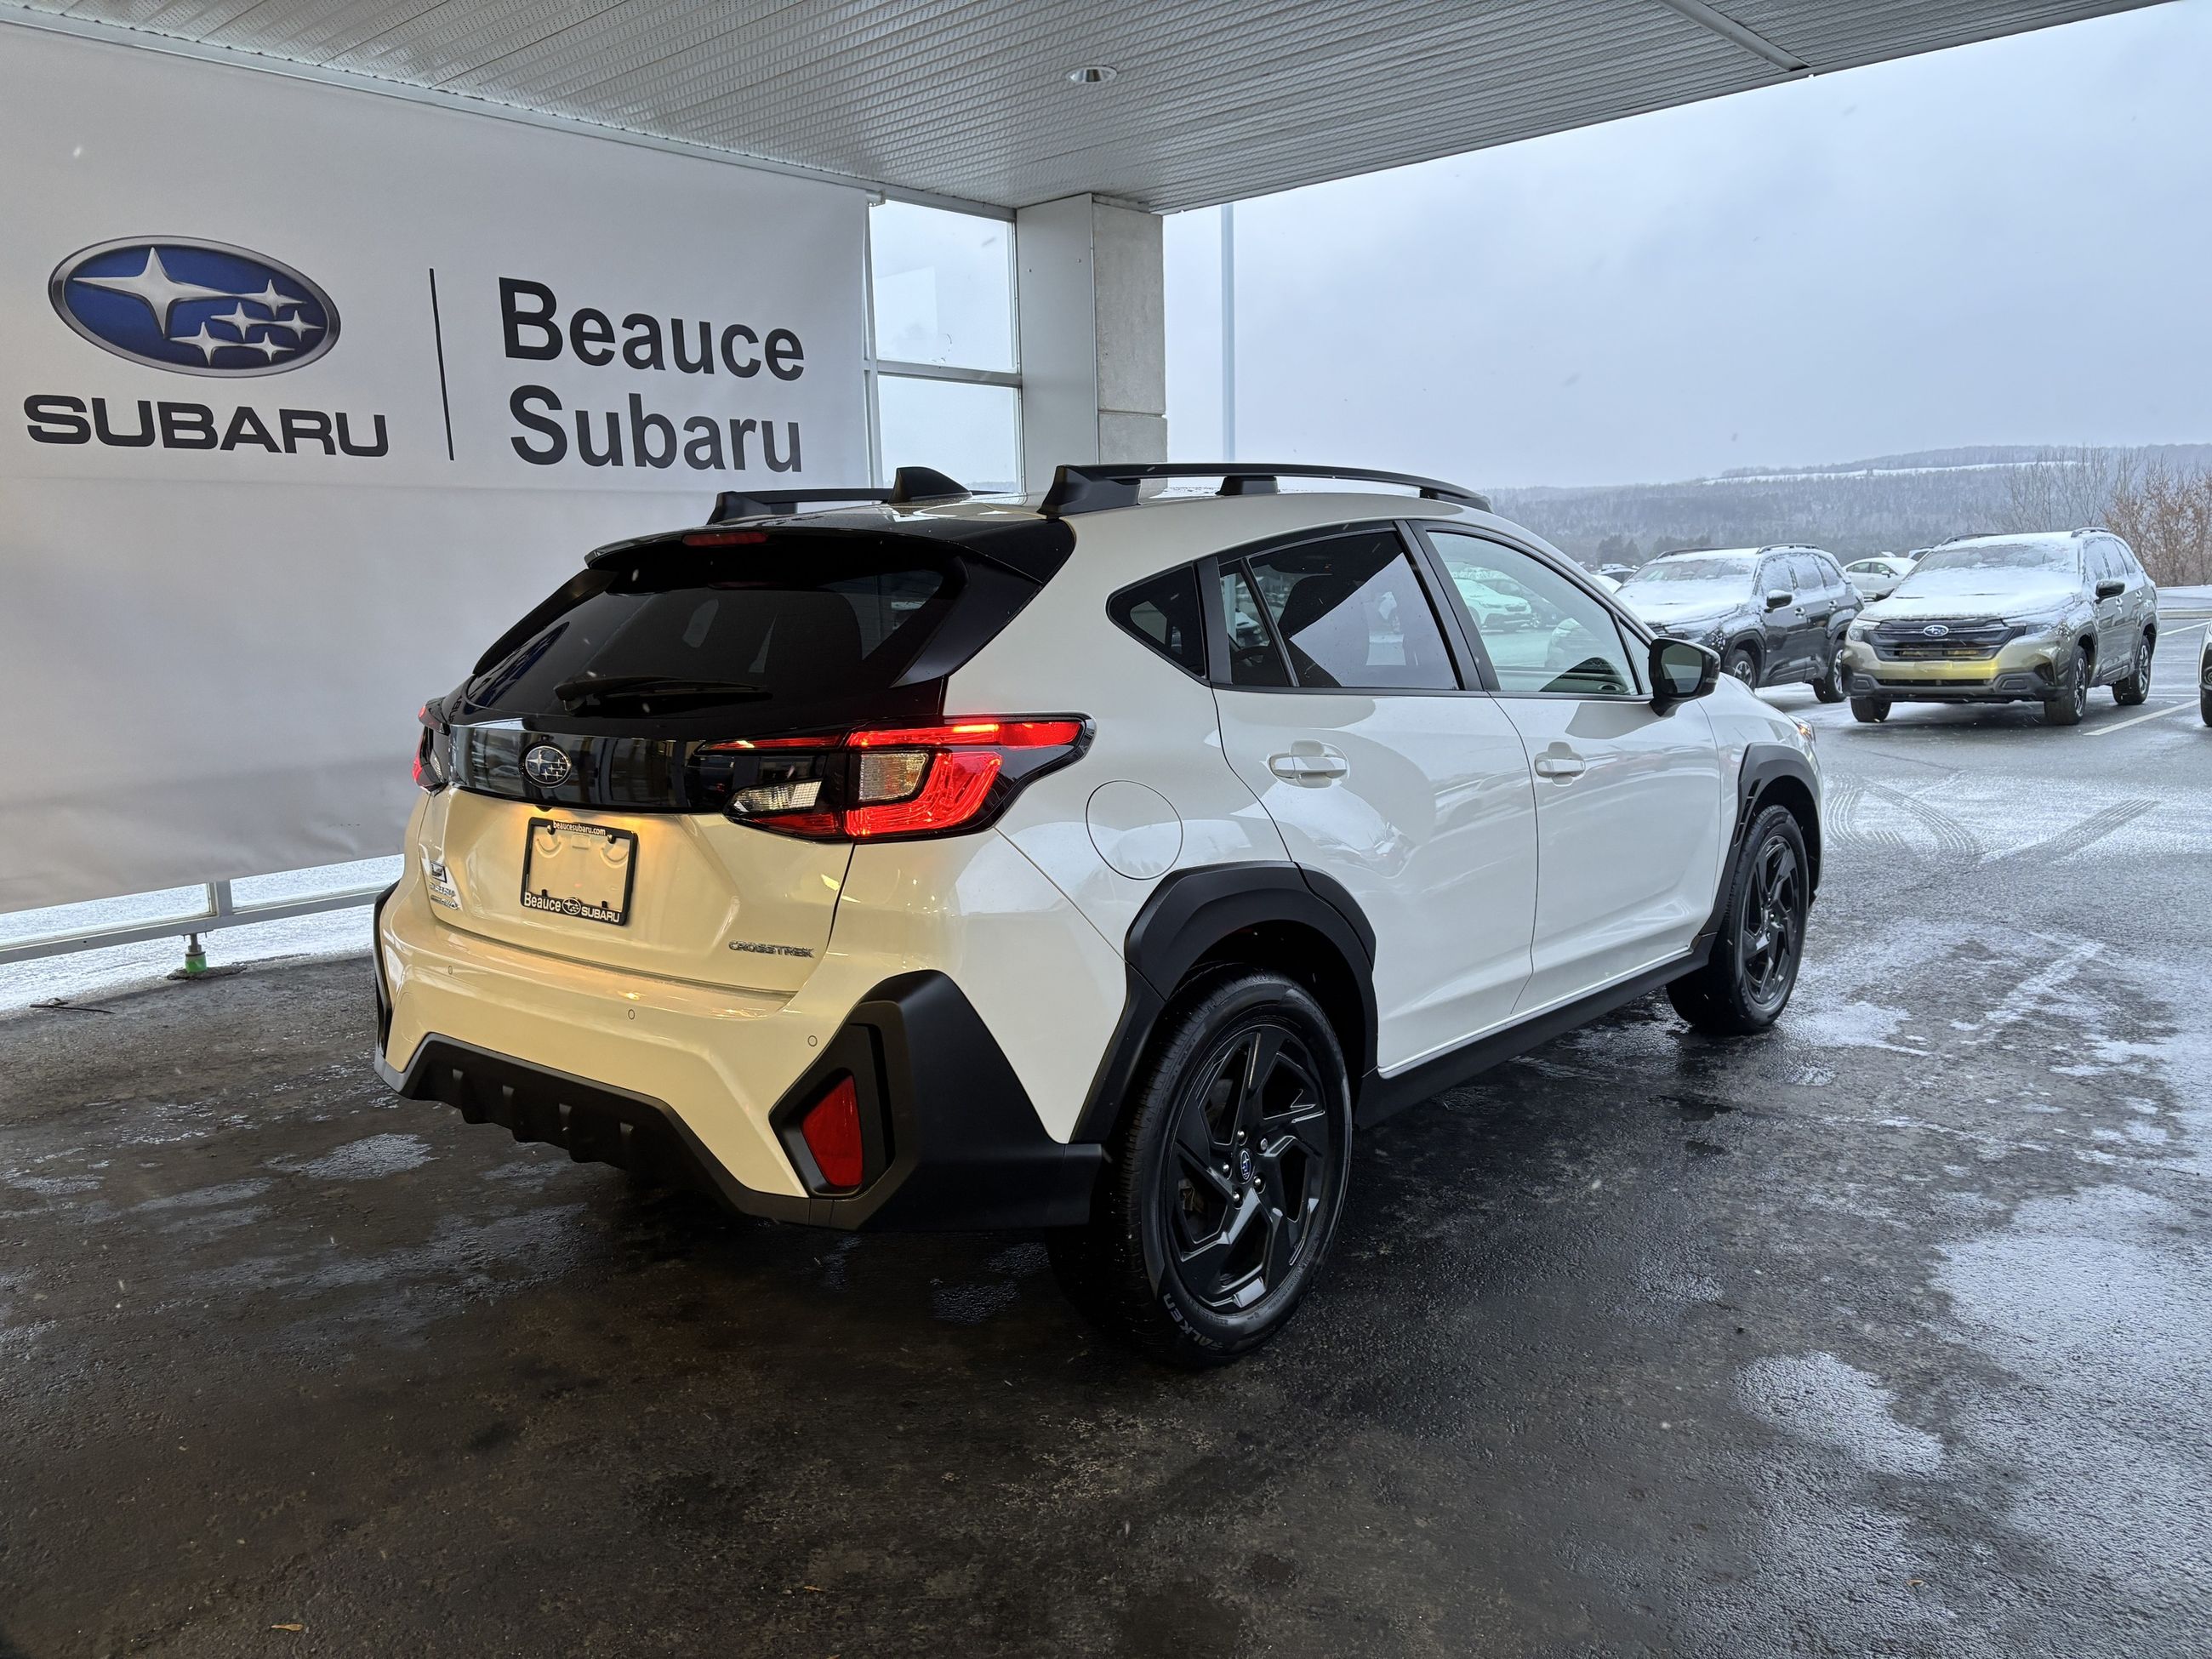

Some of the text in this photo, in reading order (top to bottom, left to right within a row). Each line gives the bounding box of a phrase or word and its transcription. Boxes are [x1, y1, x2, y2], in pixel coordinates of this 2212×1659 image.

[499, 276, 805, 381] Beauce
[24, 395, 389, 457] SUBARU
[510, 385, 802, 473] Subaru
[553, 820, 606, 836] beaucesubaru.com
[524, 892, 620, 923] Beauce SUBARU
[728, 940, 815, 959] CROSSTREK
